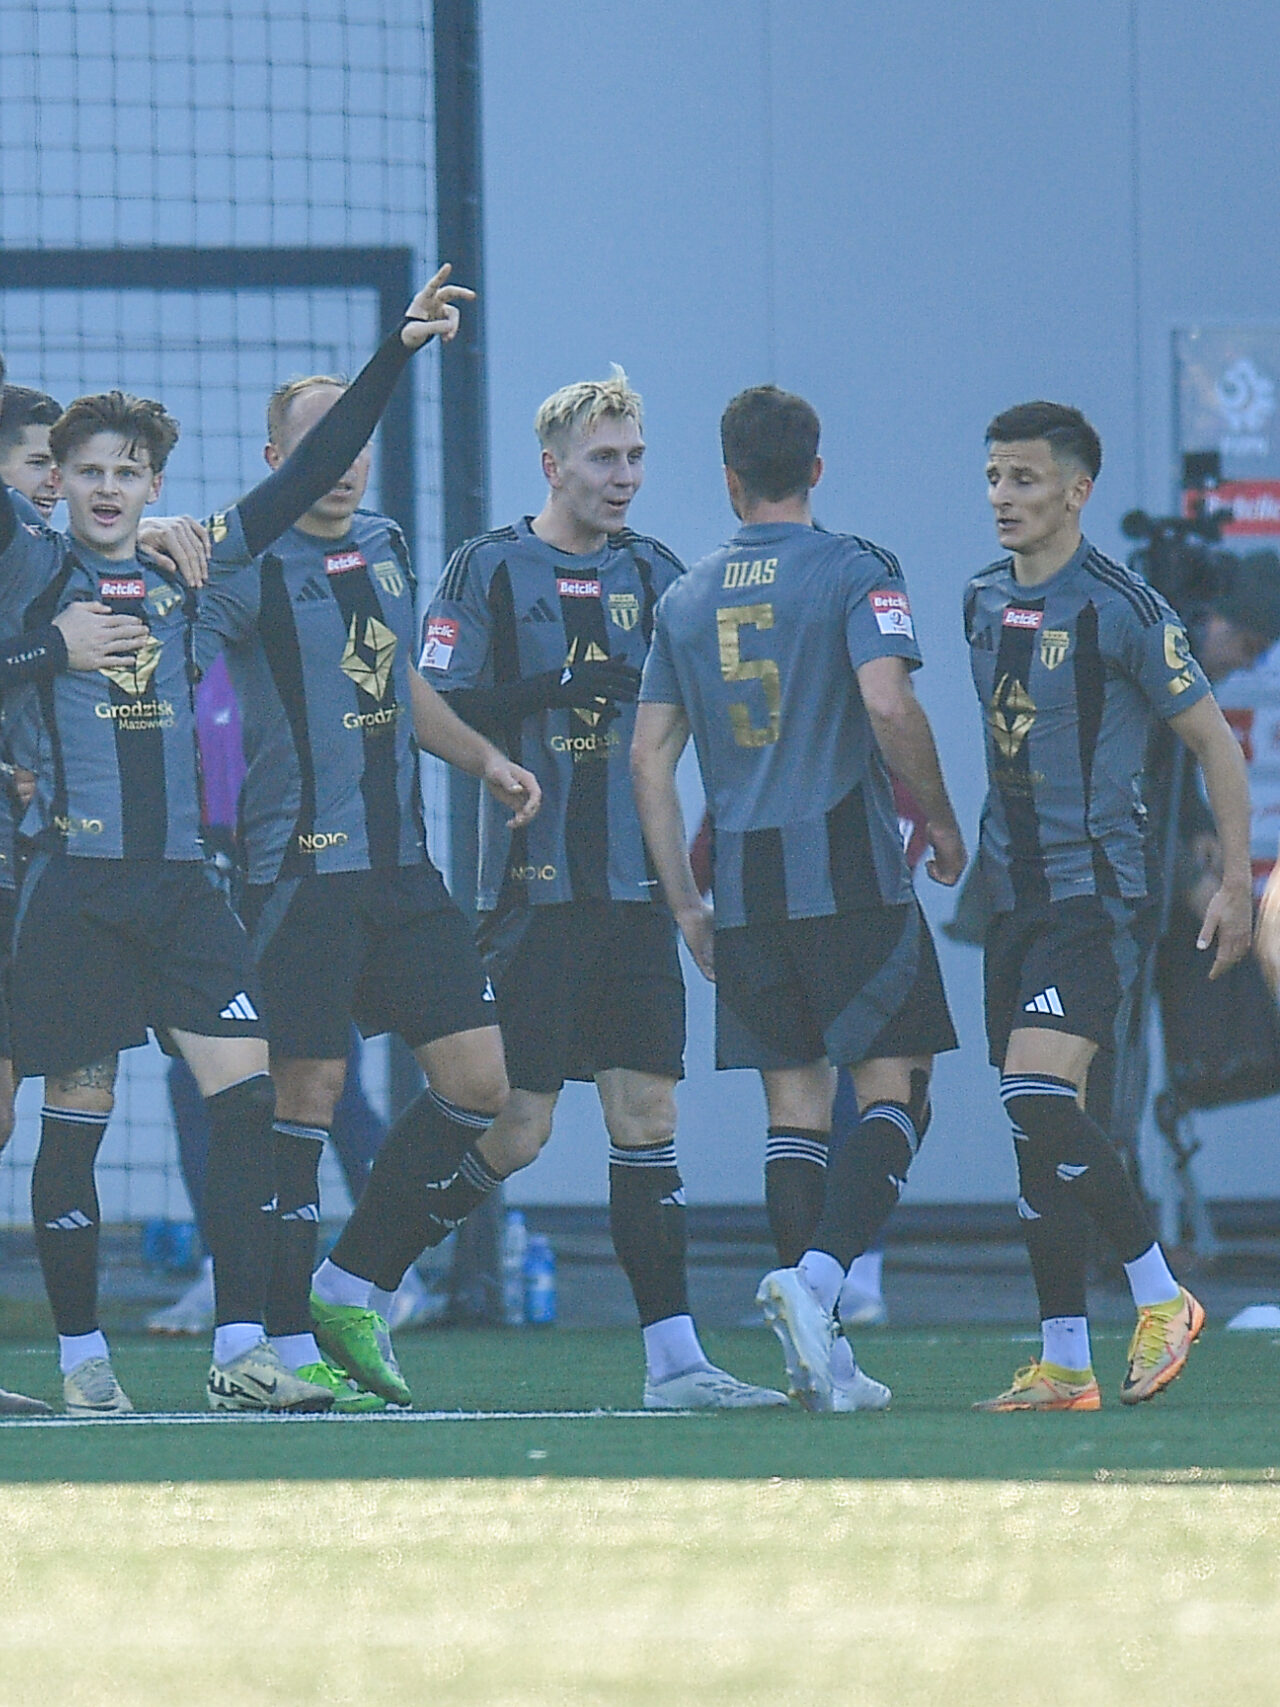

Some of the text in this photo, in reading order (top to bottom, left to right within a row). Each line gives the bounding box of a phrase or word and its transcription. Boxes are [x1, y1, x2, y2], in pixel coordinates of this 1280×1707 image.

[722, 558, 778, 589] DIAS
[101, 582, 141, 595] Betclic
[560, 581, 599, 594] Betclic
[717, 602, 780, 748] 5
[94, 699, 175, 719] Grodzisk
[343, 702, 406, 729] Grodzi
